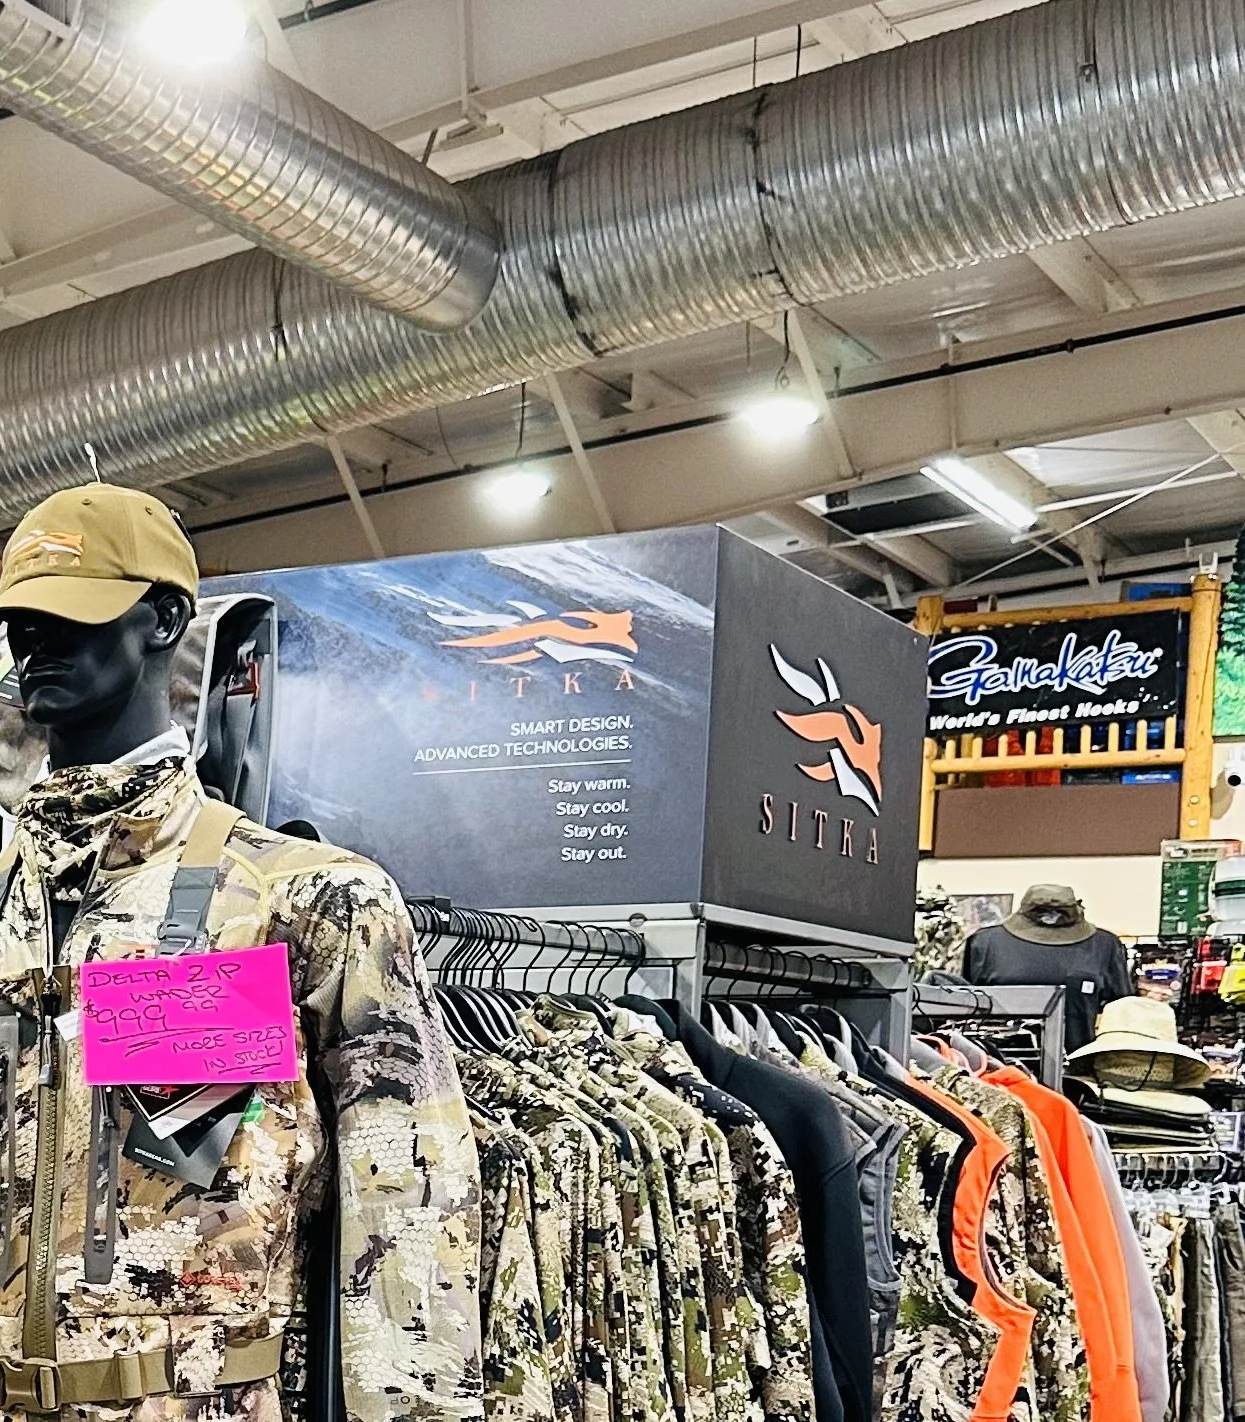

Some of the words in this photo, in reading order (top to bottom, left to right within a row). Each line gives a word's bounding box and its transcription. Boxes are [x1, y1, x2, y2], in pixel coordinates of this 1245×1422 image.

[929, 711, 1001, 730] World's
[1006, 705, 1070, 724] Finest
[1075, 699, 1139, 718] Hooks
[510, 719, 565, 737] SMART
[568, 715, 634, 733] DESIGN.
[414, 743, 500, 762] ADVANCED
[504, 735, 633, 757] TECHNOLOGIES.
[548, 779, 582, 796] Stay
[584, 778, 631, 791] warm.
[556, 801, 590, 818] Stay
[592, 799, 629, 814] cool.
[563, 823, 597, 840] Stay
[600, 822, 629, 839] dry.
[760, 792, 879, 865] SITKA
[561, 847, 595, 863] Stay
[597, 846, 627, 860] out.
[88, 969, 171, 988] DELTA
[186, 963, 242, 983] ZIP
[130, 985, 230, 1003] WADER
[172, 1033, 227, 1054] MORE
[233, 1026, 288, 1044] SIZES
[203, 1057, 227, 1072] IN
